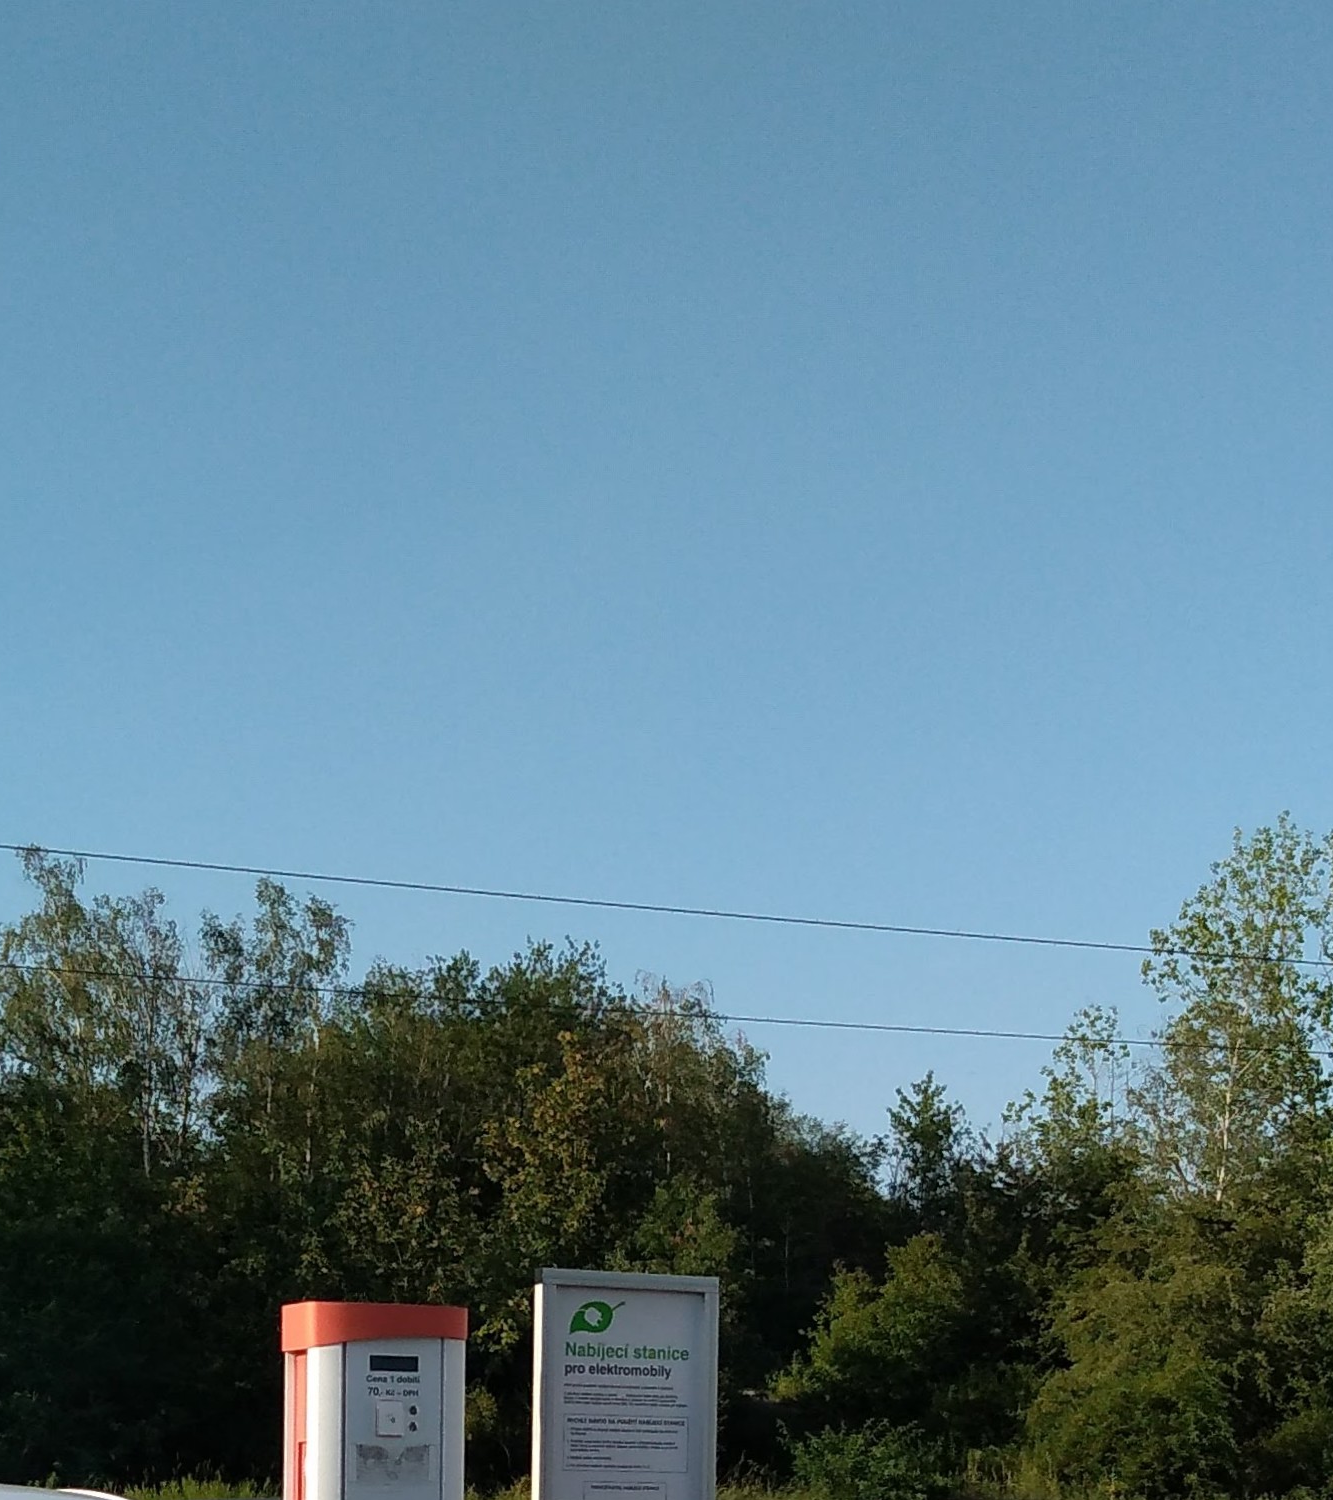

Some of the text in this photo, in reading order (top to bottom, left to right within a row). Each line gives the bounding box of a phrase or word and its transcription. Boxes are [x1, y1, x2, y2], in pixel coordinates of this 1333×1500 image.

[564, 1341, 690, 1361] Nabíjecí stanice
[366, 1374, 388, 1383] Cena
[564, 1363, 672, 1380] pro elektromobily
